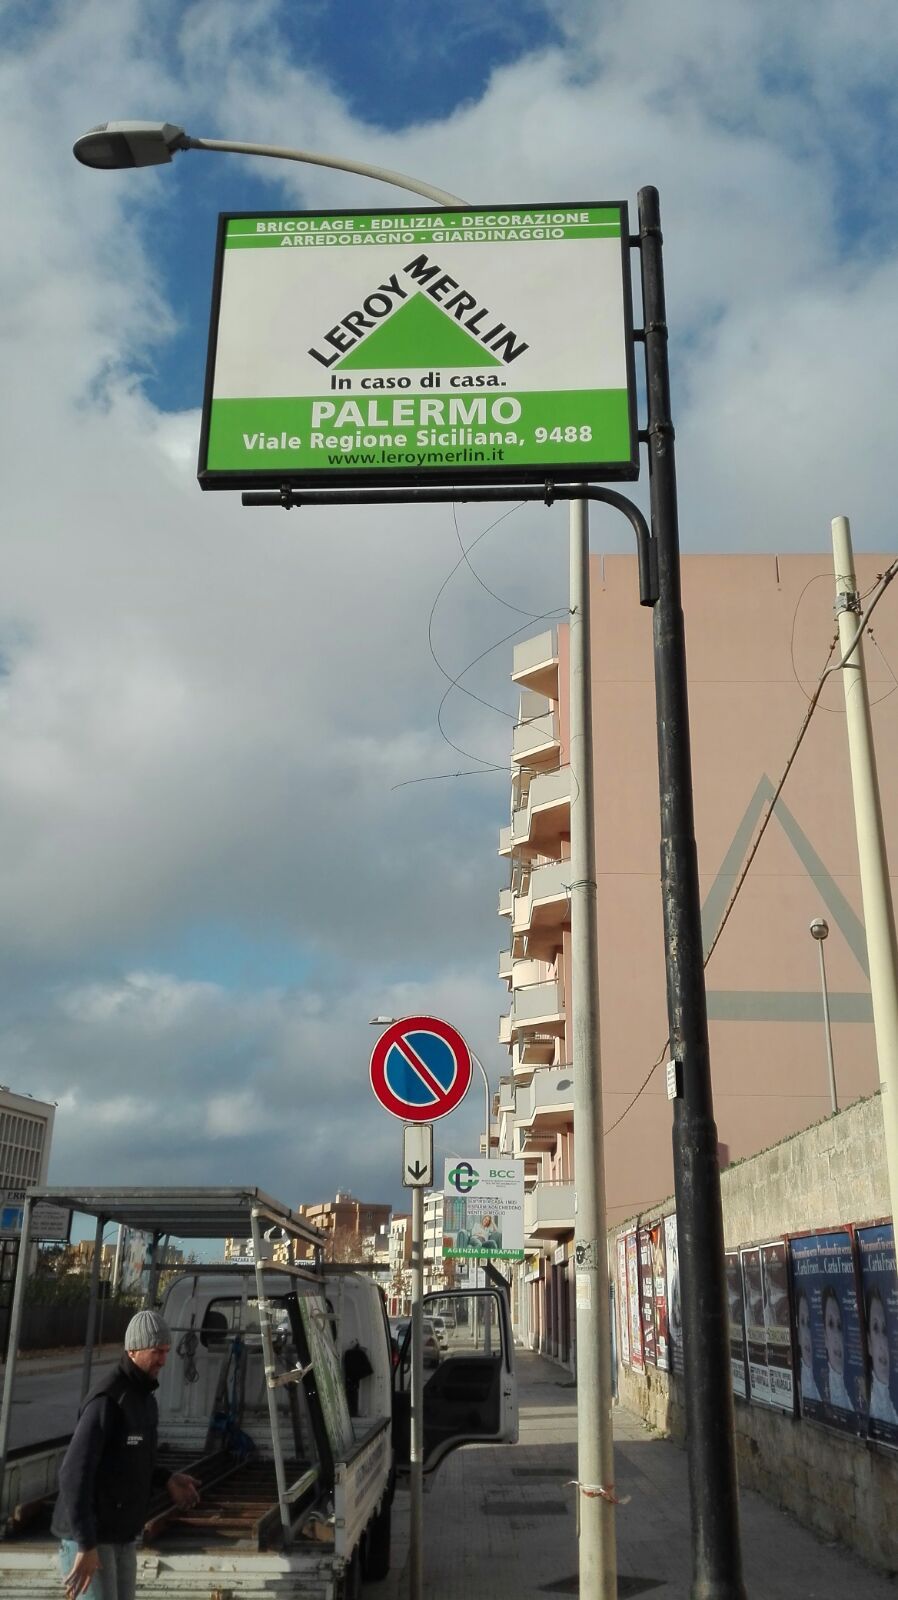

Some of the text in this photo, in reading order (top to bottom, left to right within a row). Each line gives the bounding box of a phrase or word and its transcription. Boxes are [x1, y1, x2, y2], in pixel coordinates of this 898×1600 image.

[256, 220, 354, 233] BRICOLAGE
[371, 217, 445, 230] EDILIZIA
[462, 212, 590, 227] DECORAZIONE
[280, 232, 415, 246] ARREDOBAGNO
[432, 228, 565, 242] GIARDINAGGIO
[307, 253, 530, 368] LEROY MERLIN
[330, 371, 507, 390] In caso di casa.
[311, 396, 522, 428] PALERMO
[242, 425, 593, 452] Viale Regione Siciliana, 9488
[327, 448, 505, 466] www.leroymerlin.it
[489, 1169, 516, 1179] BCC
